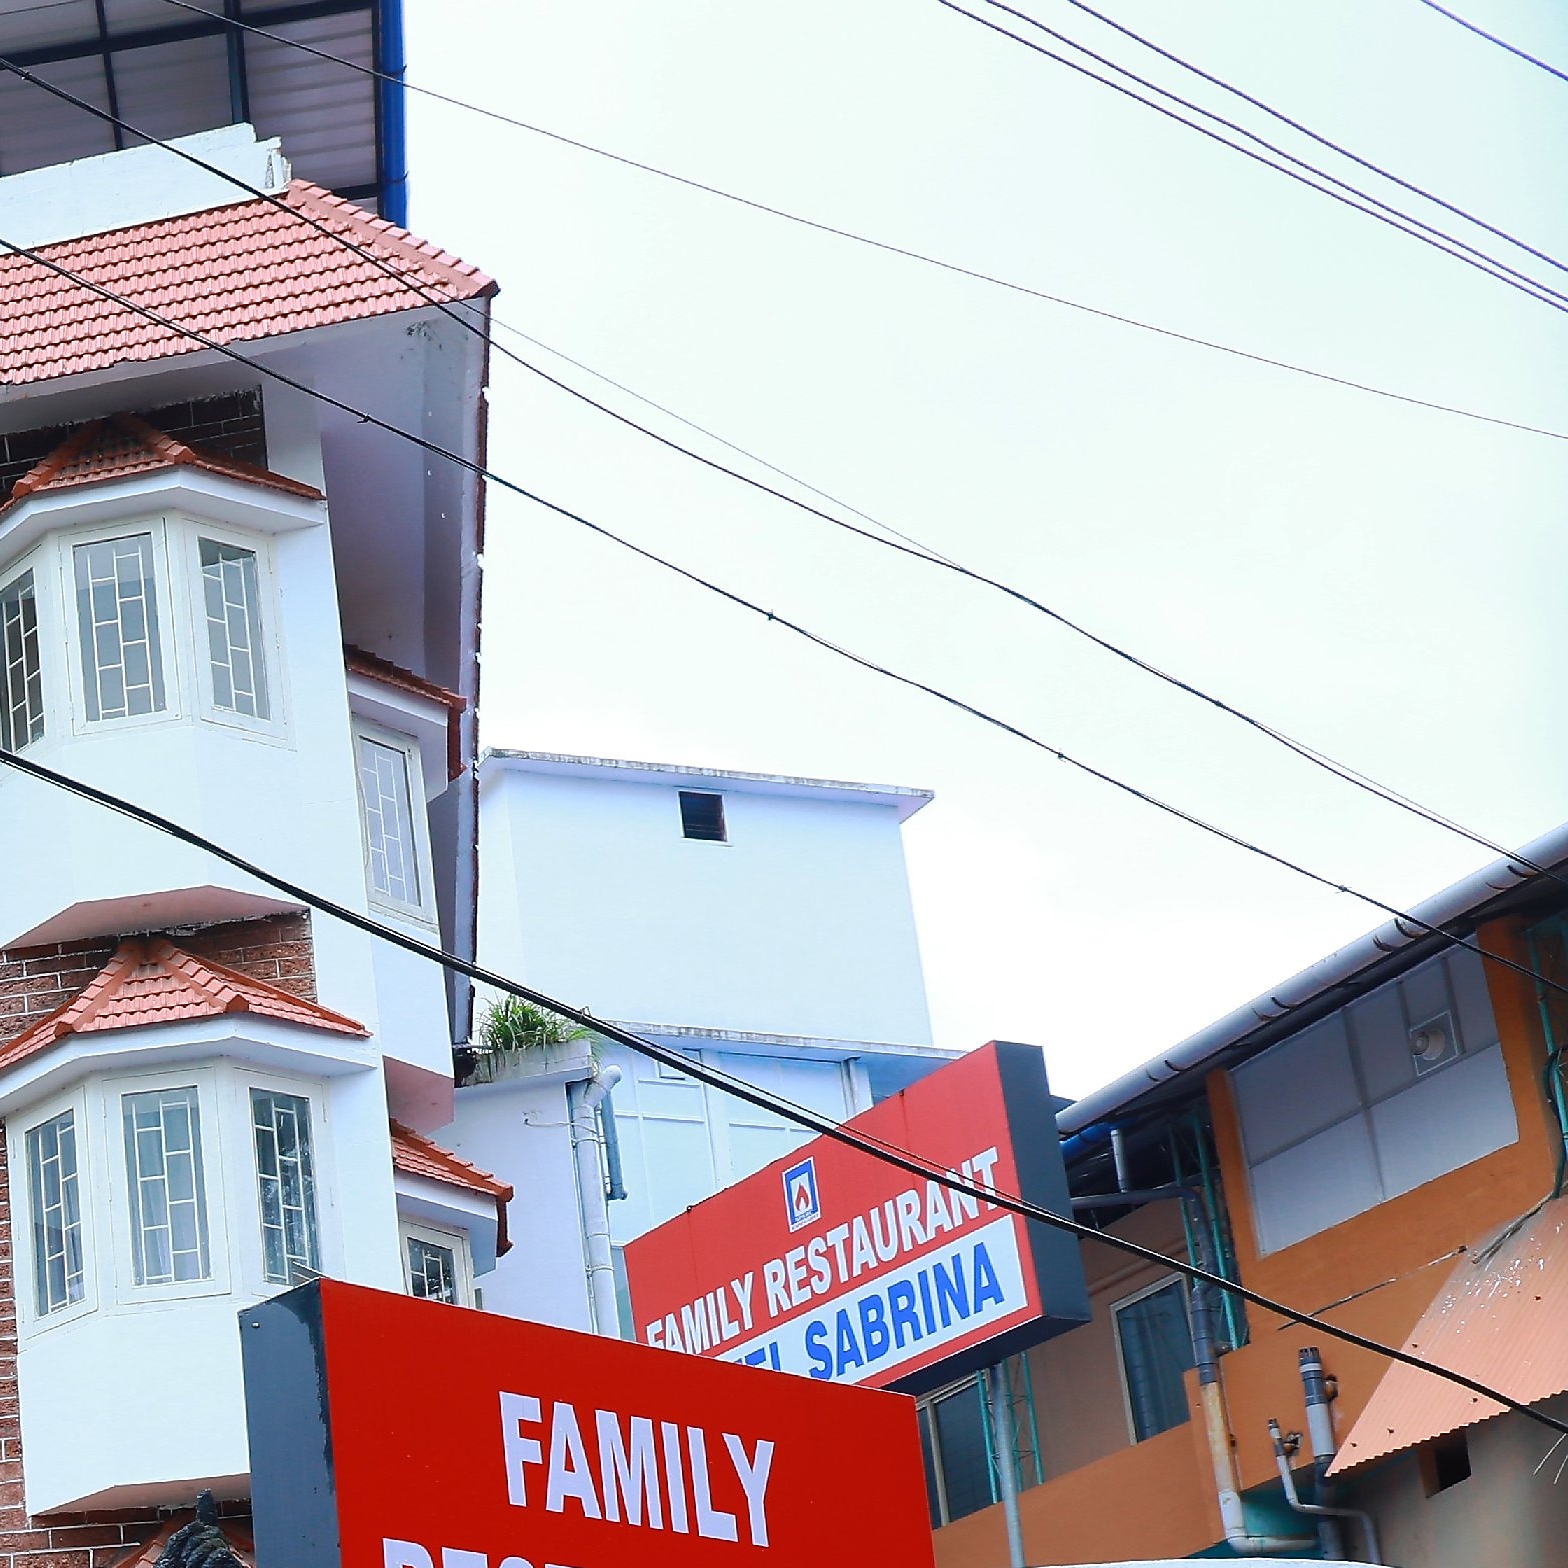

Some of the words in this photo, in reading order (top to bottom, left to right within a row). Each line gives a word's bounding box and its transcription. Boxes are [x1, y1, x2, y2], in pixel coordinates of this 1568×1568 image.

[645, 1271, 754, 1354] FAMILY
[763, 1146, 998, 1318] RESTAURANT
[805, 1242, 1005, 1380] SABRINA
[500, 1391, 775, 1547] FAMILY
